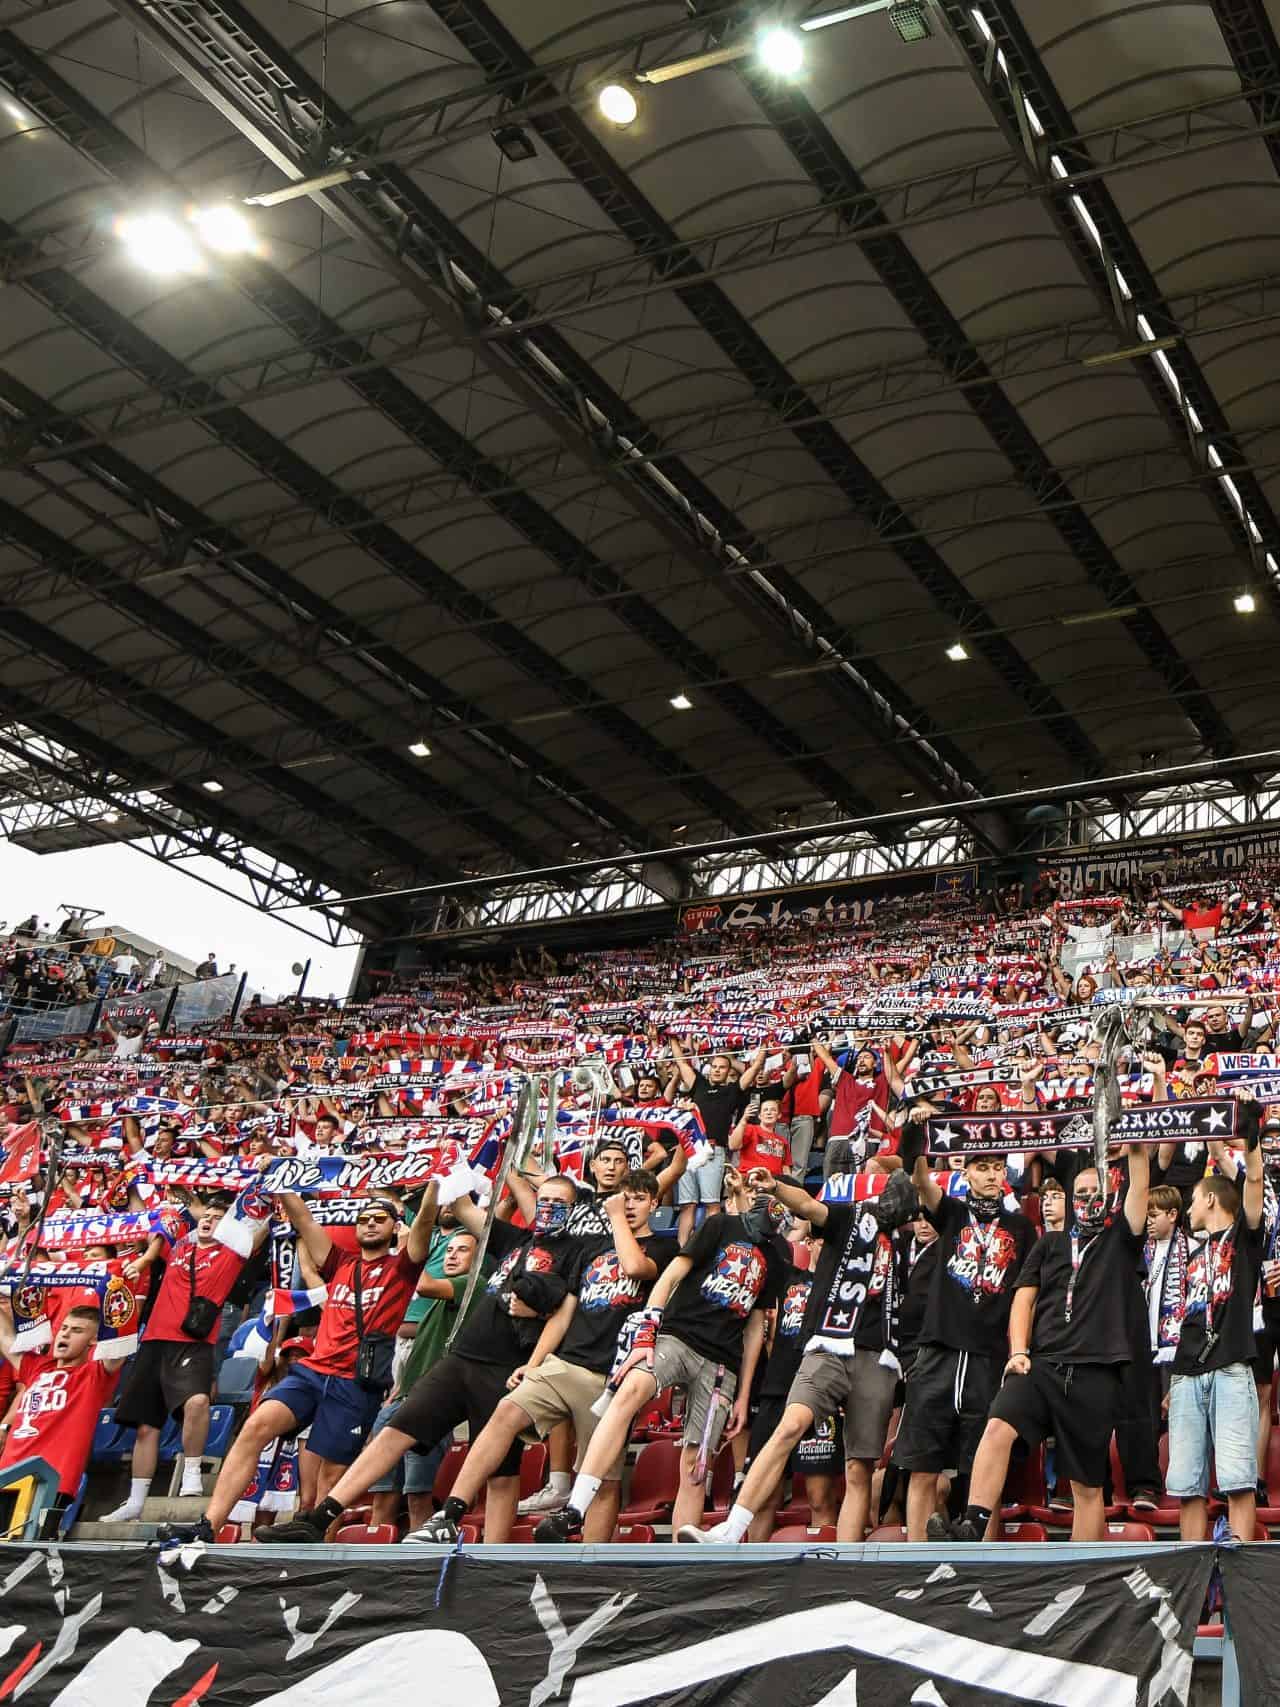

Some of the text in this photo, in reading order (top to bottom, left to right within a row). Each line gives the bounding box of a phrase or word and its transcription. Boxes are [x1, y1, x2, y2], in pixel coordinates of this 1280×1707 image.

[1222, 1054, 1271, 1069] WISŁA
[962, 1108, 1197, 1140] WISŁA RAKÓW
[41, 1212, 152, 1243] WISŁA
[13, 1260, 109, 1278] ISŁA
